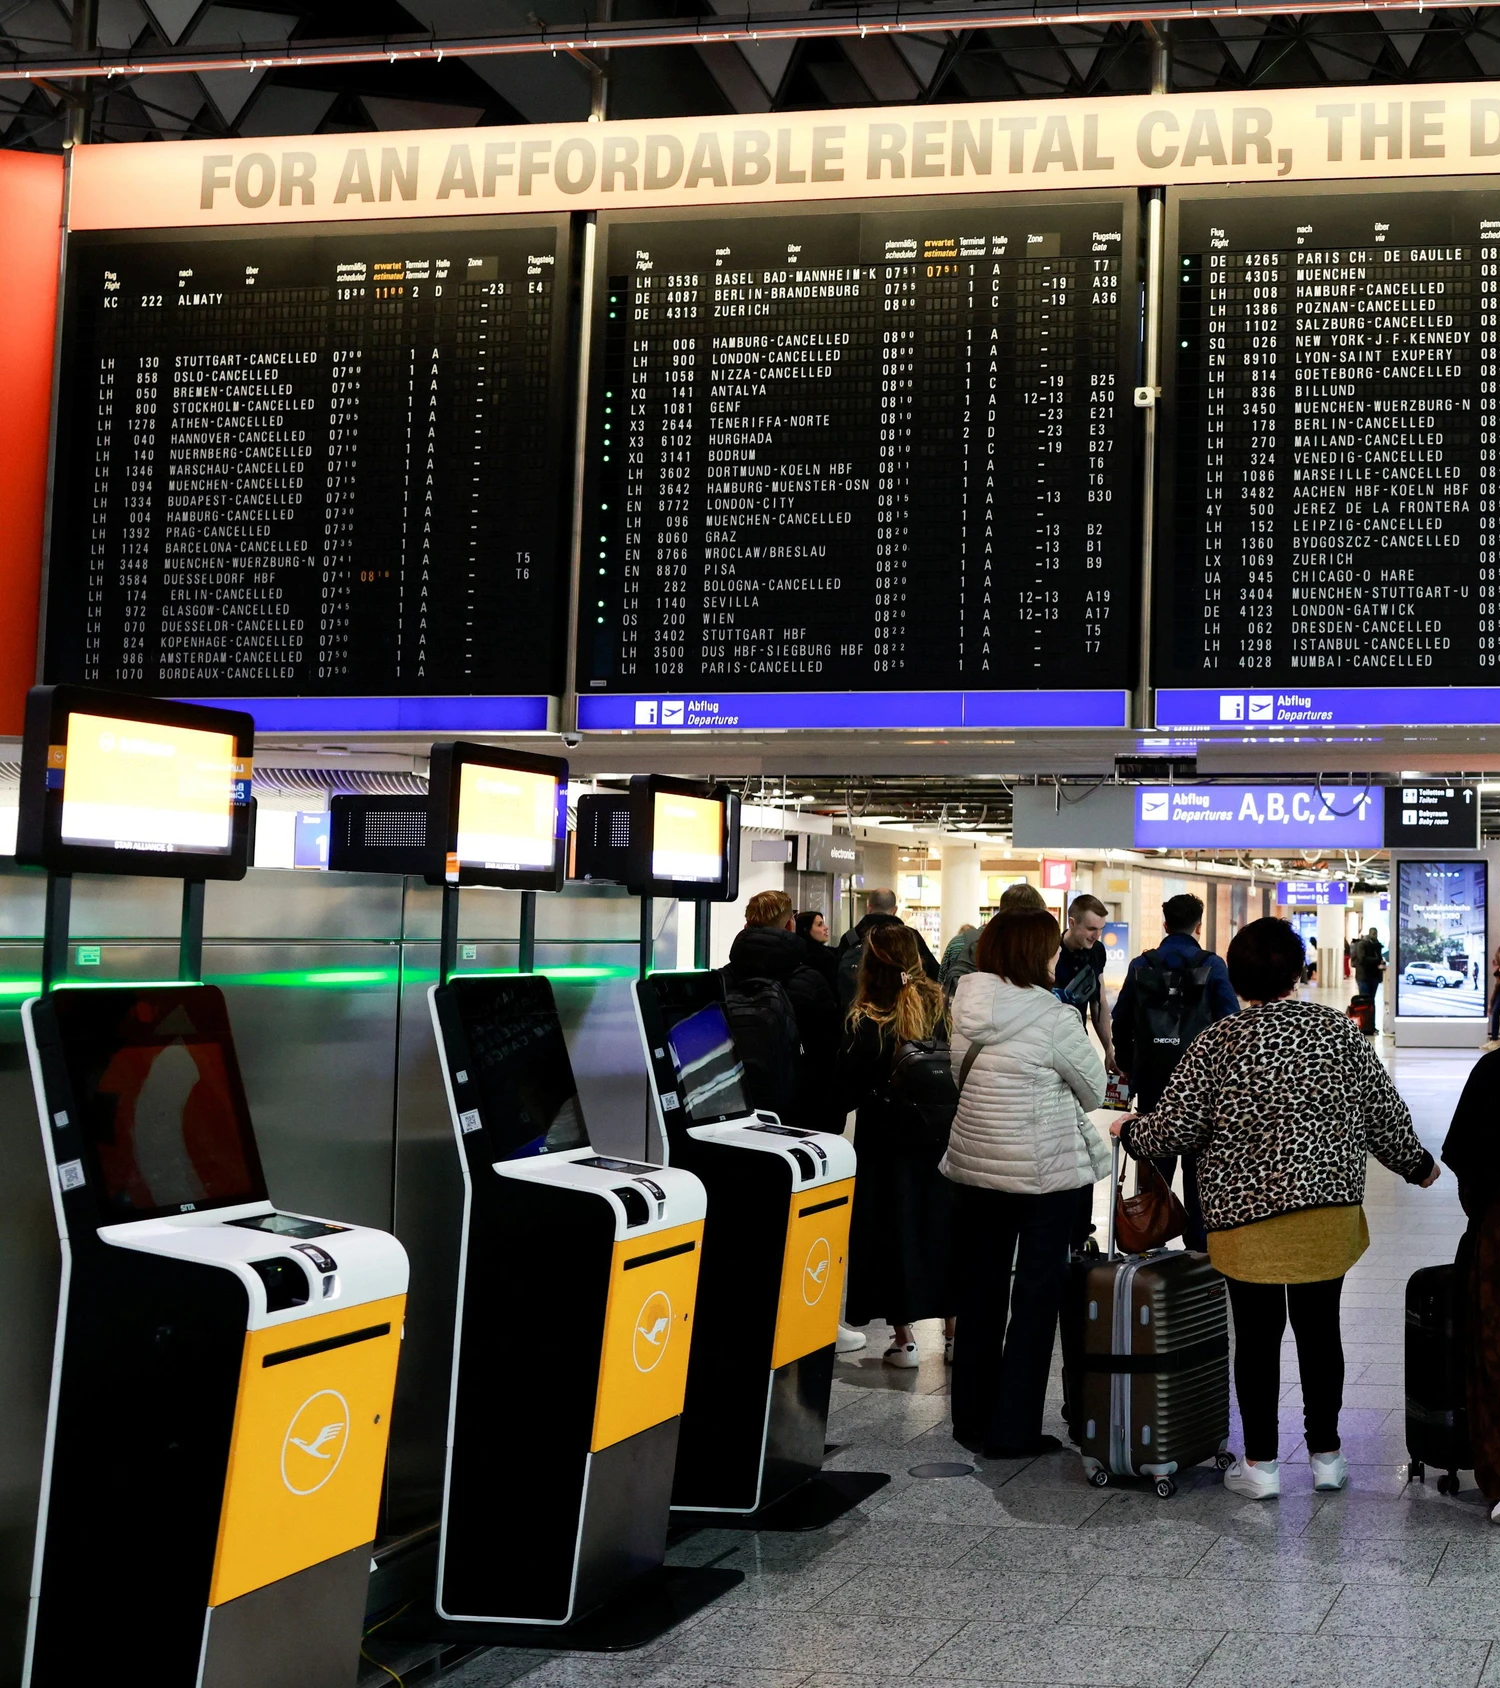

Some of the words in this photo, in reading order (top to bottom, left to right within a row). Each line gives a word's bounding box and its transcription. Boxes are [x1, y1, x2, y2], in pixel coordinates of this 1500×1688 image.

[200, 150, 317, 209] FOR
[334, 146, 420, 204] AN
[437, 125, 845, 200] AFFORDABLE
[866, 113, 1115, 179] RENTAL
[1136, 108, 1294, 177] CAR,
[1316, 100, 1446, 163] THE
[1210, 227, 1225, 238] Flug
[1296, 225, 1313, 234] nach
[1374, 222, 1390, 232] über
[1210, 238, 1229, 248] Flight
[1297, 236, 1305, 245] to
[1375, 234, 1385, 242] via
[1210, 271, 1226, 284] DE
[1245, 270, 1278, 283] 4305
[1296, 267, 1366, 281] MUENCHEN
[103, 296, 118, 309] KC
[141, 295, 163, 307] 222
[177, 293, 223, 306] ALMATY
[435, 285, 443, 297] D
[528, 281, 543, 294] E4
[634, 308, 649, 320] DE
[666, 306, 697, 319] 4313
[713, 303, 770, 317] ZUERICH
[1092, 291, 1117, 304] A36
[101, 358, 115, 370] LH
[139, 356, 159, 369] 130
[175, 351, 317, 368] STUTTGART-CANCELLED
[631, 387, 647, 400] XQ
[672, 386, 693, 398] 141
[710, 383, 767, 397] ANTALYA
[1090, 373, 1115, 386] B25
[1208, 387, 1224, 400] LH
[1251, 385, 1276, 399] 836
[1295, 384, 1355, 397] BILLUND
[95, 466, 109, 478] LH
[126, 465, 153, 477] 1346
[169, 461, 304, 476] WARSCHAU-CANCELLED
[1206, 470, 1223, 483] LH
[1242, 469, 1275, 482] 1086
[1293, 466, 1461, 481] MARSEILLE-CANCELLED
[626, 500, 642, 512] EN
[658, 499, 689, 512] 8772
[707, 496, 795, 511] LONDON-CITY
[1088, 489, 1112, 502] B30
[90, 559, 104, 571] LH
[119, 558, 148, 570] 3448
[164, 555, 315, 570] MUENCHEN-WUERZBURG-N
[516, 551, 531, 564] T5
[623, 597, 638, 610] LH
[656, 596, 686, 609] 1140
[703, 595, 759, 609] SEVILLA
[1085, 590, 1111, 602] A19
[1204, 605, 1220, 618] DE
[1239, 604, 1273, 617] 4123
[1292, 603, 1415, 617] LONDON-GATWICK
[85, 653, 100, 665] LH
[122, 652, 144, 664] 986
[159, 650, 303, 664] AMSTERDAM-CANCELLED
[687, 700, 719, 714] Abflug
[1277, 695, 1312, 708] Abflug
[687, 714, 739, 727] Departures
[1277, 709, 1333, 722] Departures
[1418, 788, 1445, 796] Toiletten
[1172, 793, 1210, 808] Abflug
[1172, 808, 1234, 823] Departures
[1418, 818, 1433, 826] Baby
